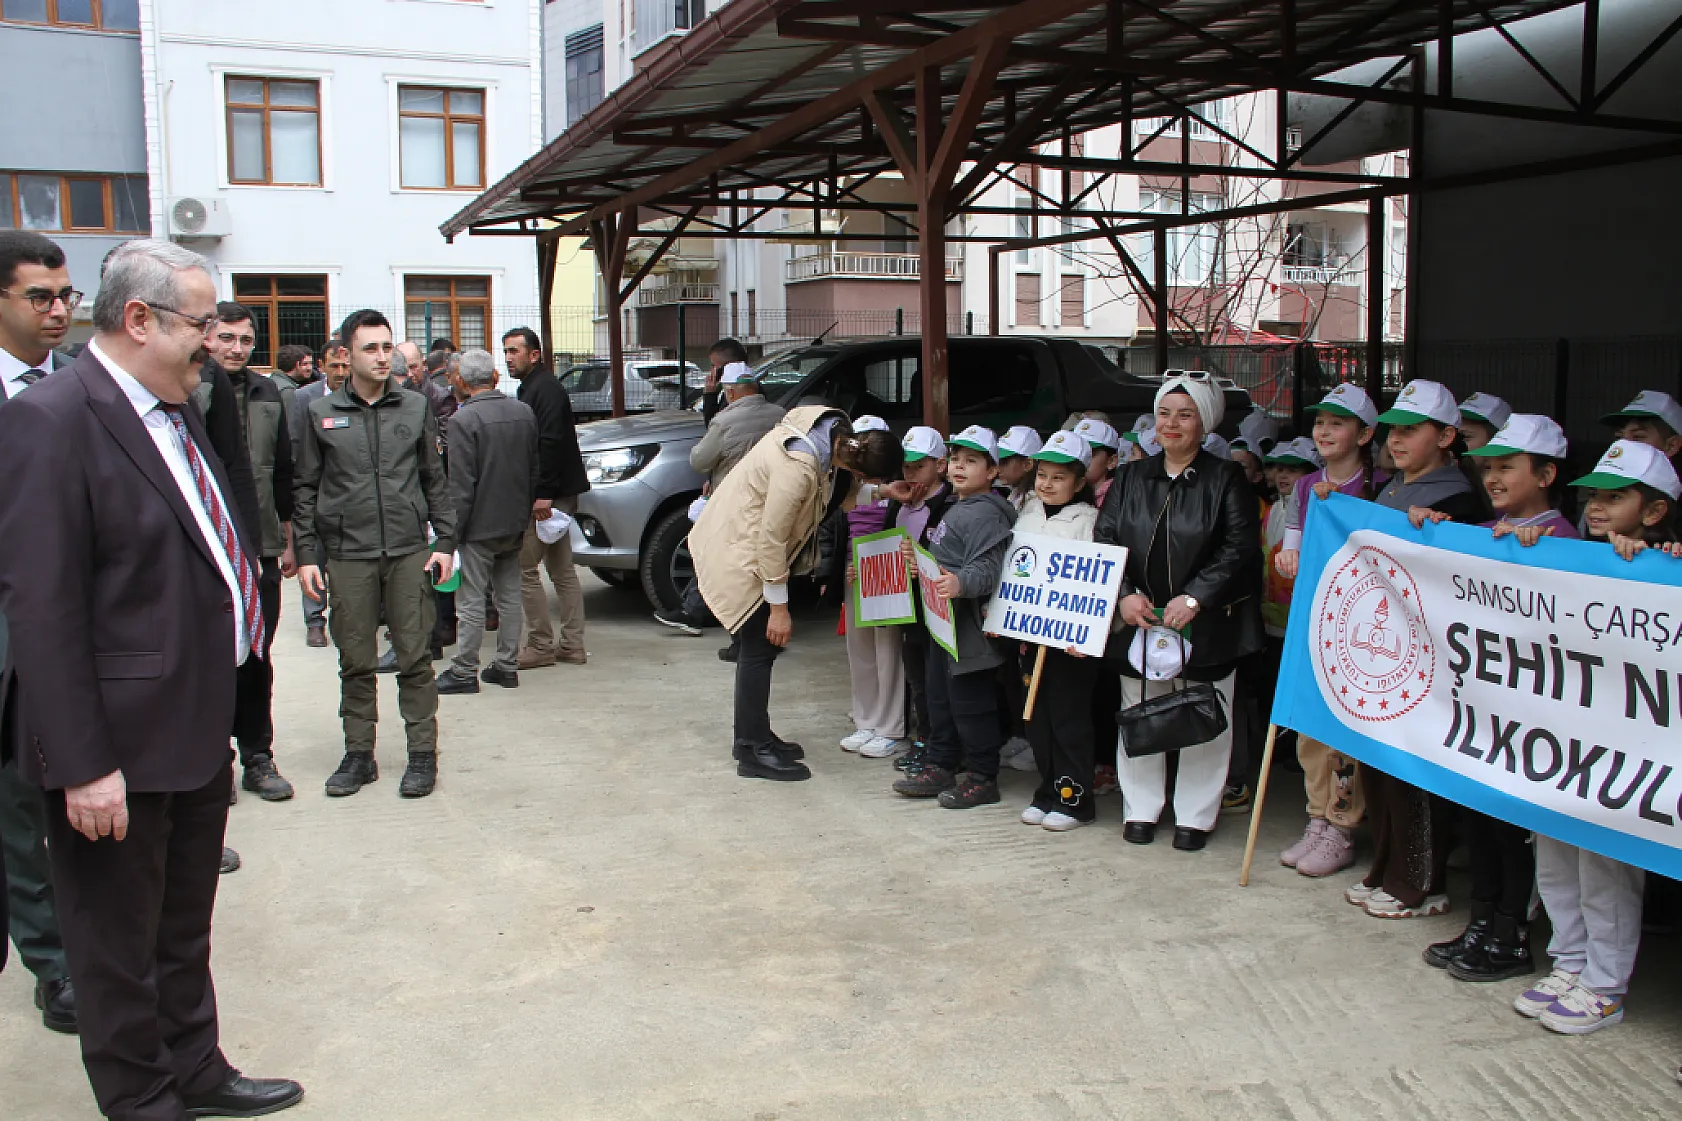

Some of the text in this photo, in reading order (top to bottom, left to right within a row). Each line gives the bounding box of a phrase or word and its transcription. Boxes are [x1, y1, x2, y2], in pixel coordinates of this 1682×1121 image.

[1046, 552, 1116, 585] ŞEHİT
[999, 581, 1108, 618] NURİ PAMİR
[1451, 574, 1556, 623] SAMSUN
[1003, 605, 1090, 645] İLKOKULU
[1446, 622, 1682, 727] ŞEHİT N
[1443, 688, 1682, 827] İLKOKUL
